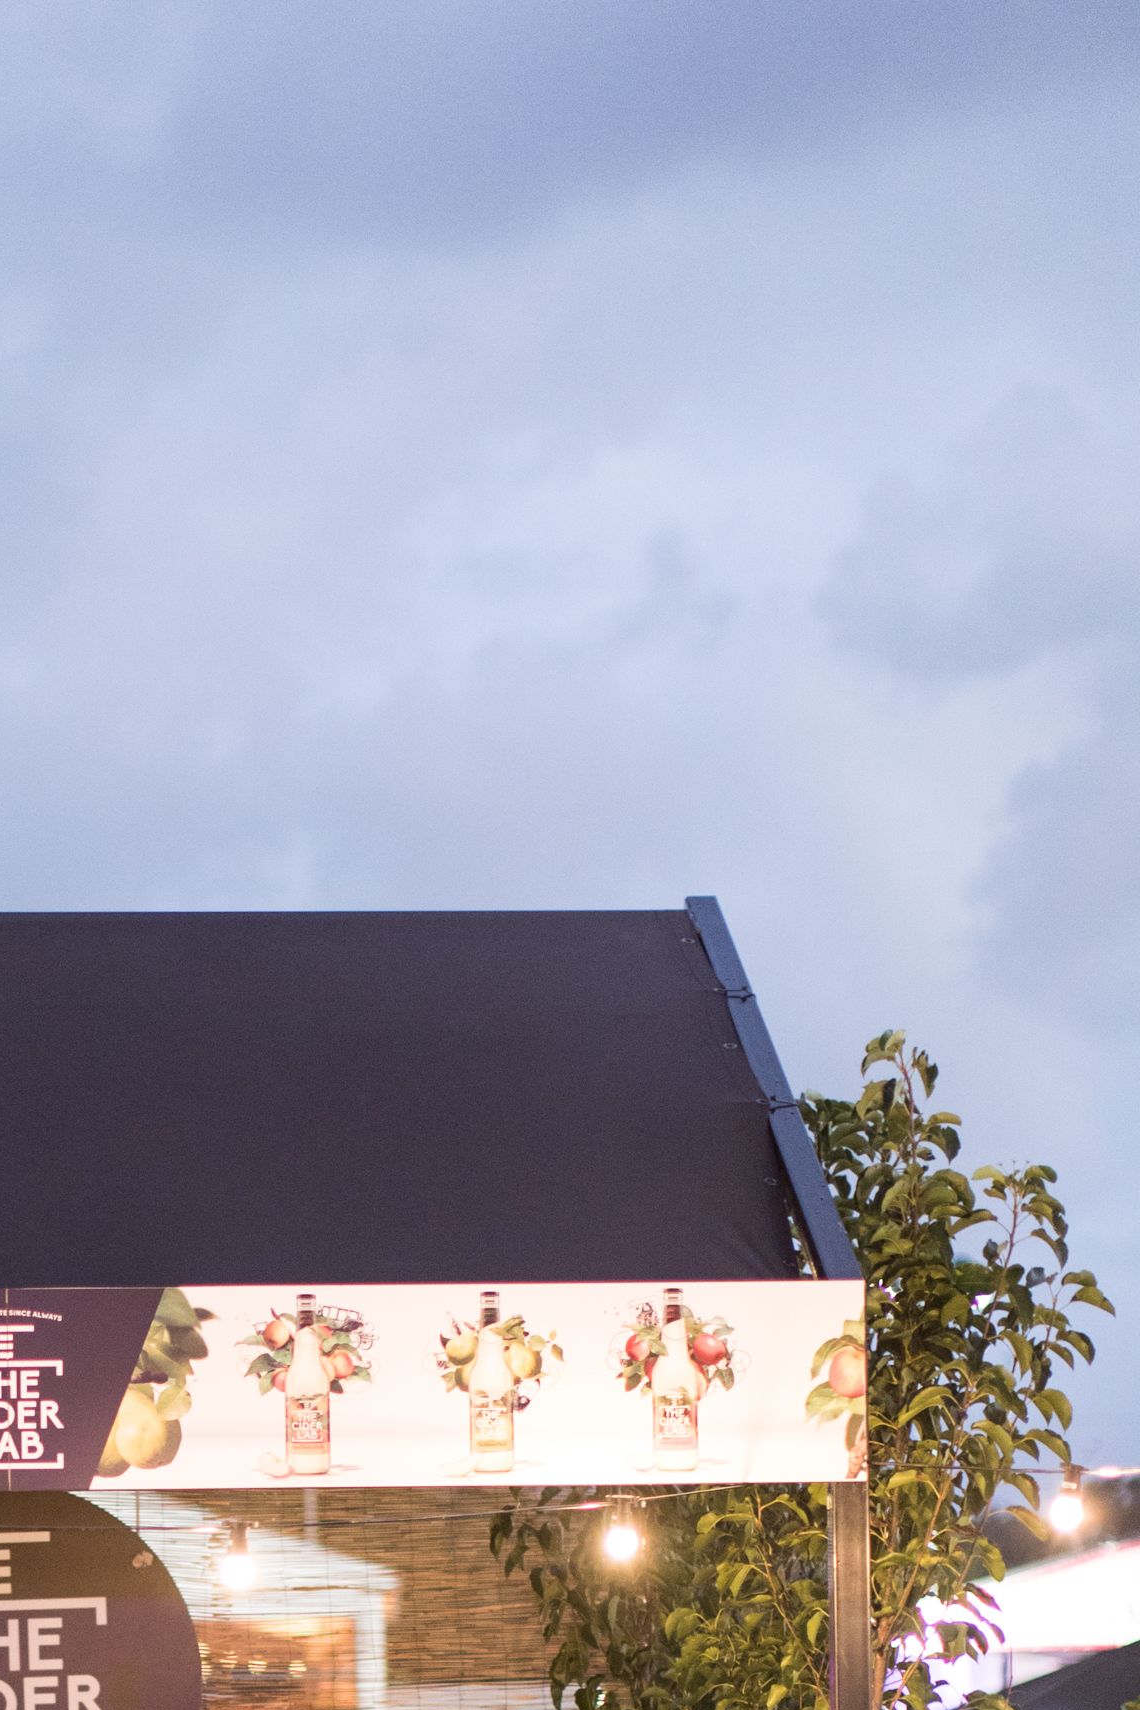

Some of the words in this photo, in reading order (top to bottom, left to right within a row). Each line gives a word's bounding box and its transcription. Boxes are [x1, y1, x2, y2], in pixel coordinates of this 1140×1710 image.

[9, 1309, 31, 1317] SINCE
[32, 1311, 63, 1322] ALWAYS
[292, 1422, 323, 1430] CIDER
[296, 1431, 318, 1439] LAB
